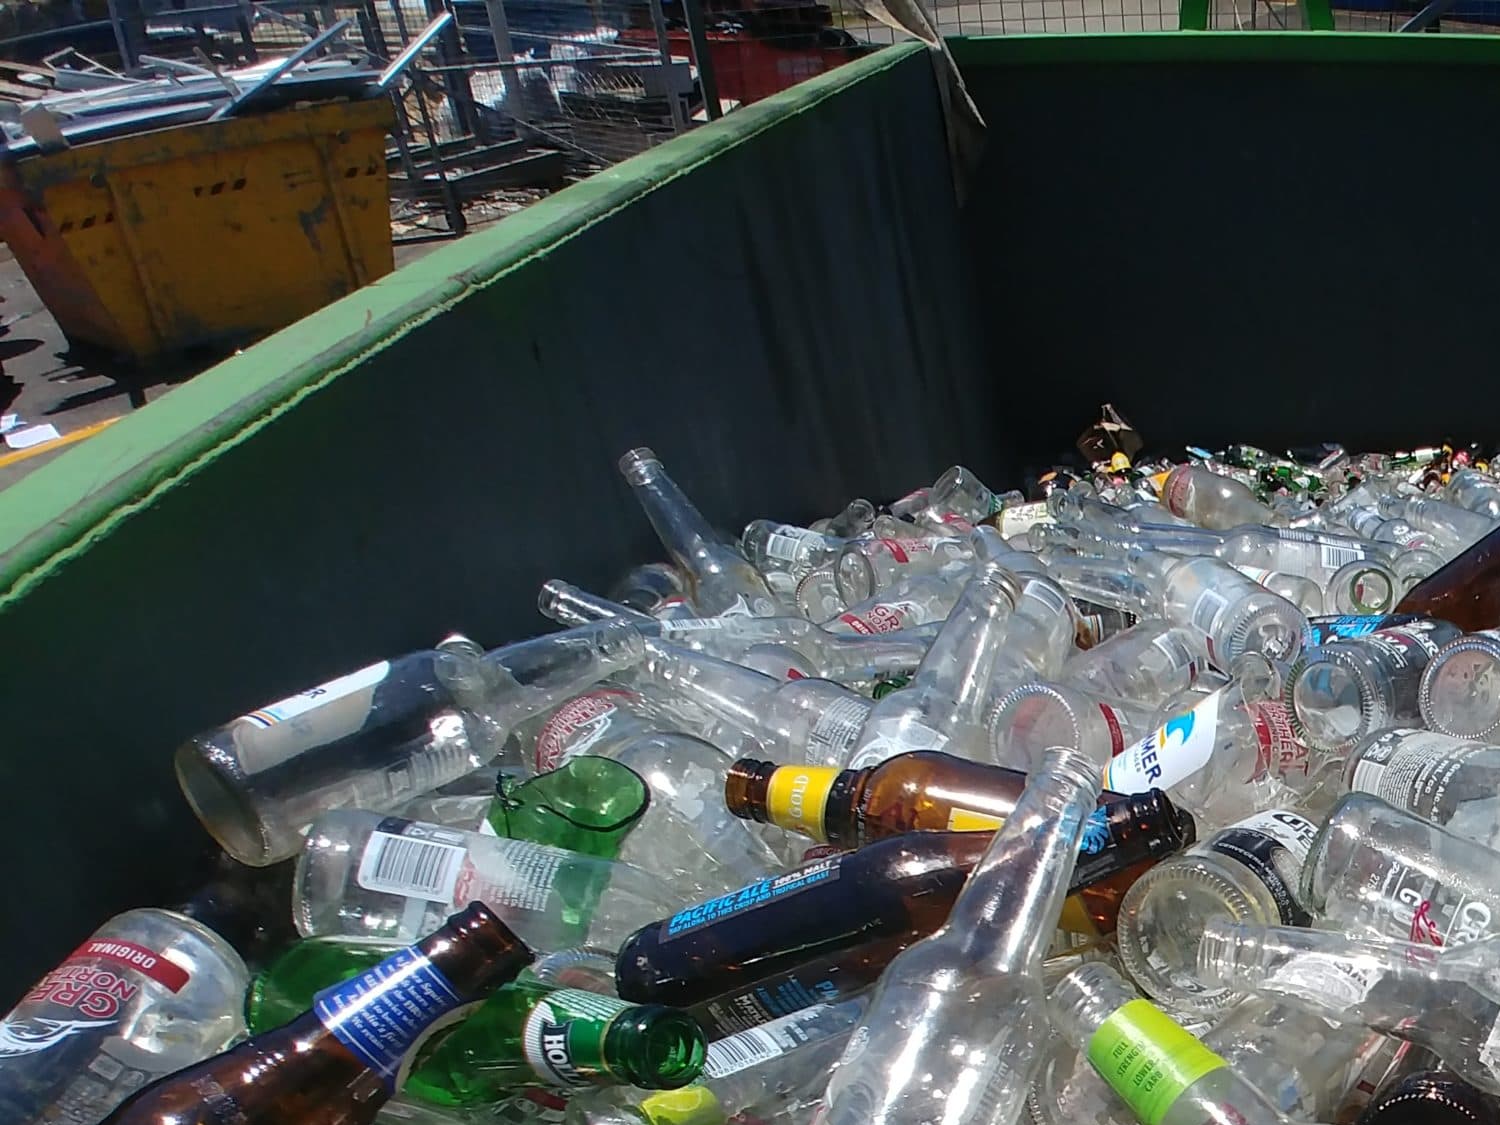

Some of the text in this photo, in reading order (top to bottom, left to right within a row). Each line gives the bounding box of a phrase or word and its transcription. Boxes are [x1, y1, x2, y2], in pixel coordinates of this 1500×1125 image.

[790, 774, 809, 819] GOLD
[667, 894, 734, 927] PACIFIC
[733, 879, 773, 902] ALE
[88, 941, 157, 969] ORIGINAL
[1112, 1041, 1129, 1059] FULL
[1117, 1042, 1146, 1077] STRENGTH
[1144, 1070, 1164, 1093] CARB
